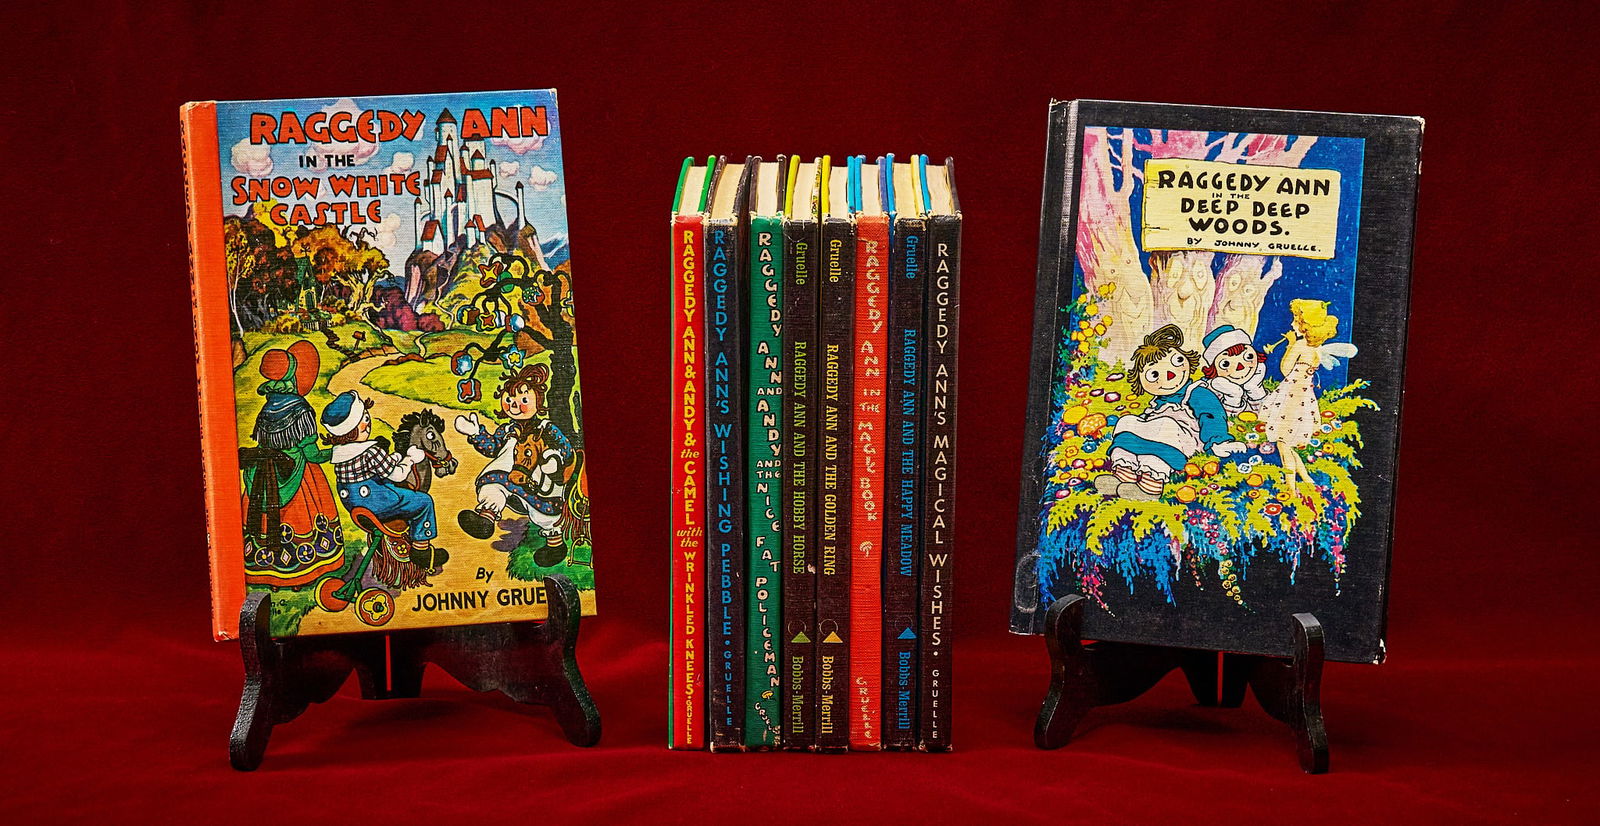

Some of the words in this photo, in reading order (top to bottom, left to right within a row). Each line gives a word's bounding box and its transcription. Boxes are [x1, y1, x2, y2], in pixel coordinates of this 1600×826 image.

[250, 109, 426, 145] RAGGEDY
[461, 106, 548, 139] ANN
[300, 155, 317, 168] IN
[325, 154, 355, 167] THE
[231, 176, 320, 205] SNOW
[328, 171, 421, 198] WHITE
[1158, 170, 1270, 192] RAGGEDY
[1276, 177, 1331, 196] ANN
[270, 200, 381, 226] CASTLE
[1181, 197, 1240, 215] DEEP
[1252, 201, 1310, 219] DEEP
[1189, 217, 1290, 236] WOODS.
[829, 239, 842, 283] Gruelle
[906, 235, 919, 279] Gruelle
[1187, 237, 1202, 246] BY
[1214, 240, 1260, 249] JOHNNY
[683, 230, 696, 323] RAGGEDY
[796, 242, 808, 285] Gruelle
[713, 230, 728, 341] RAGGEDY
[758, 232, 782, 337] RAGGEDY
[865, 240, 883, 334] RAGGEDY
[936, 243, 949, 354] RAGGEDY
[757, 341, 782, 384] ANN
[794, 341, 807, 398] RAGGEDY
[826, 344, 839, 402] RAGGEDY
[861, 340, 880, 377] ANN
[903, 329, 917, 385] RAGGEDY
[715, 352, 729, 414] ANN'S
[757, 387, 782, 396] AND
[863, 388, 881, 396] IN
[934, 363, 949, 426] ANN'S
[793, 402, 806, 428] ANN
[826, 405, 838, 431] ANN
[859, 402, 881, 413] THE
[903, 390, 915, 416] ANN
[757, 399, 782, 456] ANDY
[793, 432, 806, 457] AND
[902, 421, 915, 445] AND
[680, 449, 700, 459] the
[757, 460, 781, 468] AND
[825, 435, 837, 460] AND
[857, 421, 876, 474] MAGIC
[902, 449, 914, 474] THE
[684, 461, 696, 525] CAMEL
[714, 424, 732, 533] WISHING
[756, 470, 781, 479] THE
[793, 461, 805, 487] THE
[825, 464, 837, 490] THE
[933, 435, 949, 544] MAGICAL
[757, 483, 781, 532] NICE
[793, 491, 805, 530] HOBBY
[824, 494, 837, 541] GOLDEN
[860, 477, 878, 522] BOOK
[901, 480, 914, 519] HAPPY
[677, 527, 702, 537] with
[680, 538, 698, 548] the
[900, 524, 913, 577] MEADOW
[756, 536, 781, 572] FAT
[792, 535, 805, 574] HORSE
[823, 545, 836, 576] RING
[476, 567, 494, 583] By
[684, 551, 696, 635] WRINKLED
[721, 543, 732, 636] PEBBLE
[412, 590, 489, 612] JOHNNY
[497, 587, 547, 607] GRUE
[928, 554, 948, 646] WISHES
[755, 577, 780, 687] POLICEMAN
[723, 651, 733, 726] GRUELLE
[855, 677, 873, 739] GRUELLE
[932, 669, 940, 739] GRUELLE
